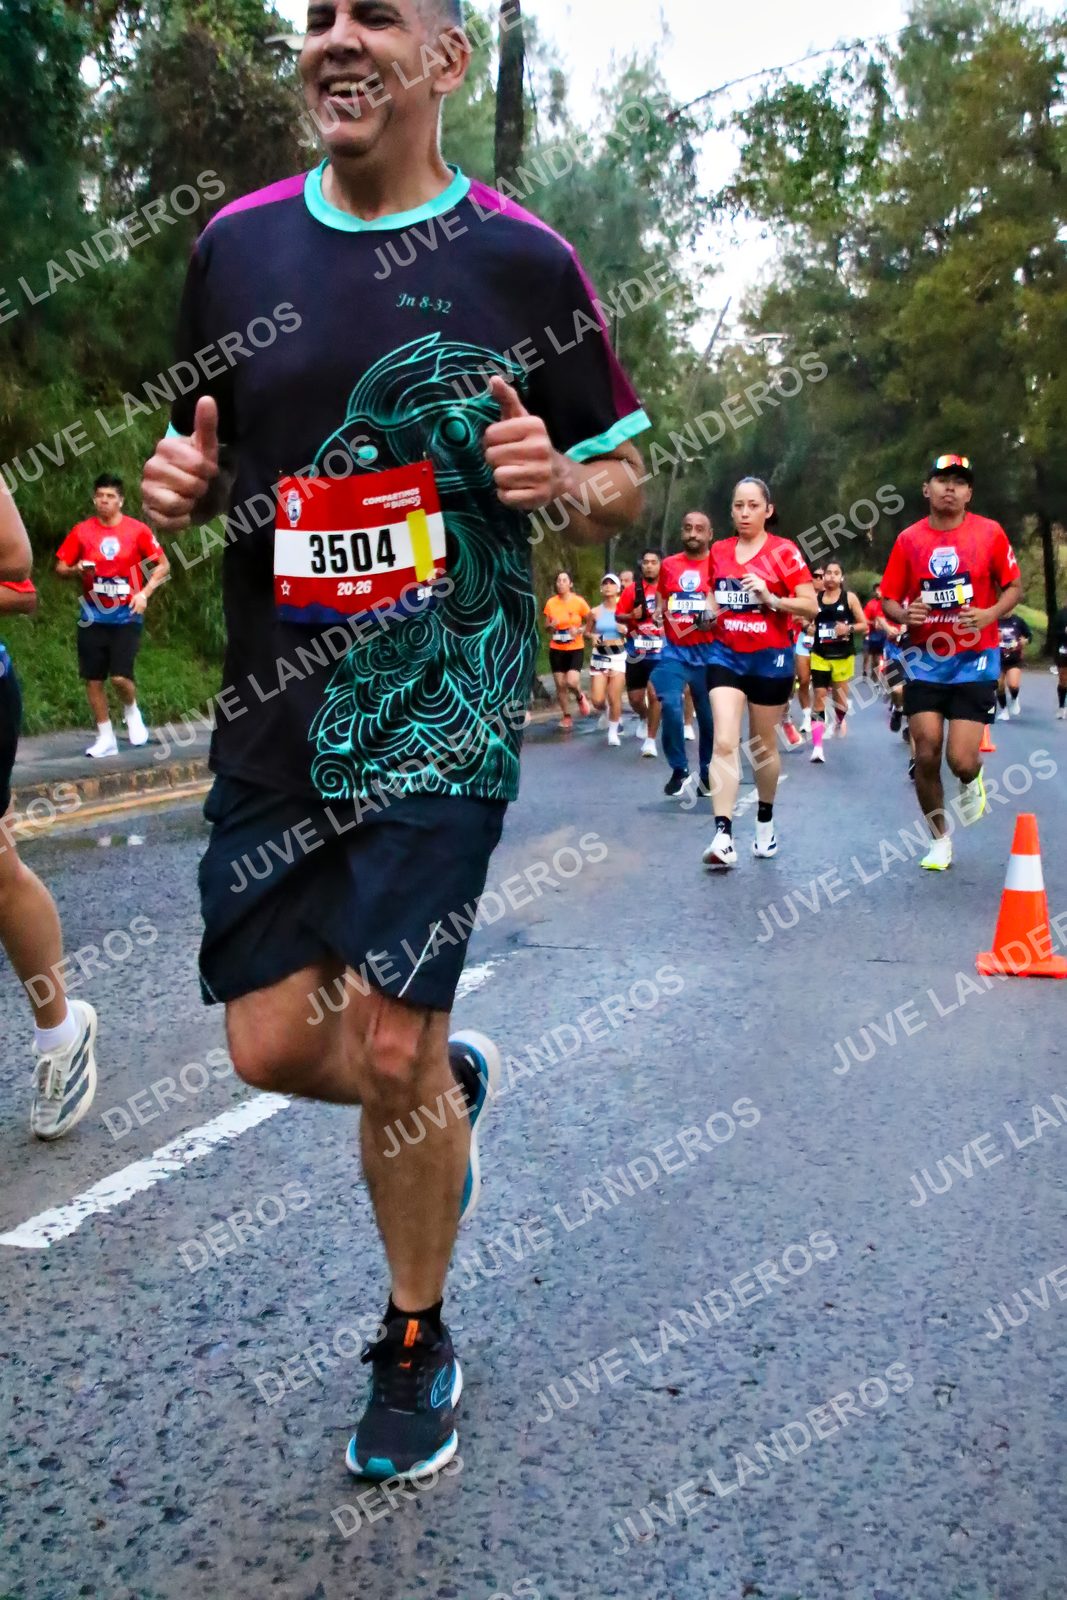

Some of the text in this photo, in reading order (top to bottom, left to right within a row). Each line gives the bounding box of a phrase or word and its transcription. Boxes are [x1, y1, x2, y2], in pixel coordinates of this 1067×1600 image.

[420, 296, 452, 313] 8-32
[309, 528, 396, 574] 3504
[337, 580, 372, 596] 20-26
[934, 590, 956, 602] 4413
[727, 592, 750, 604] 5346
